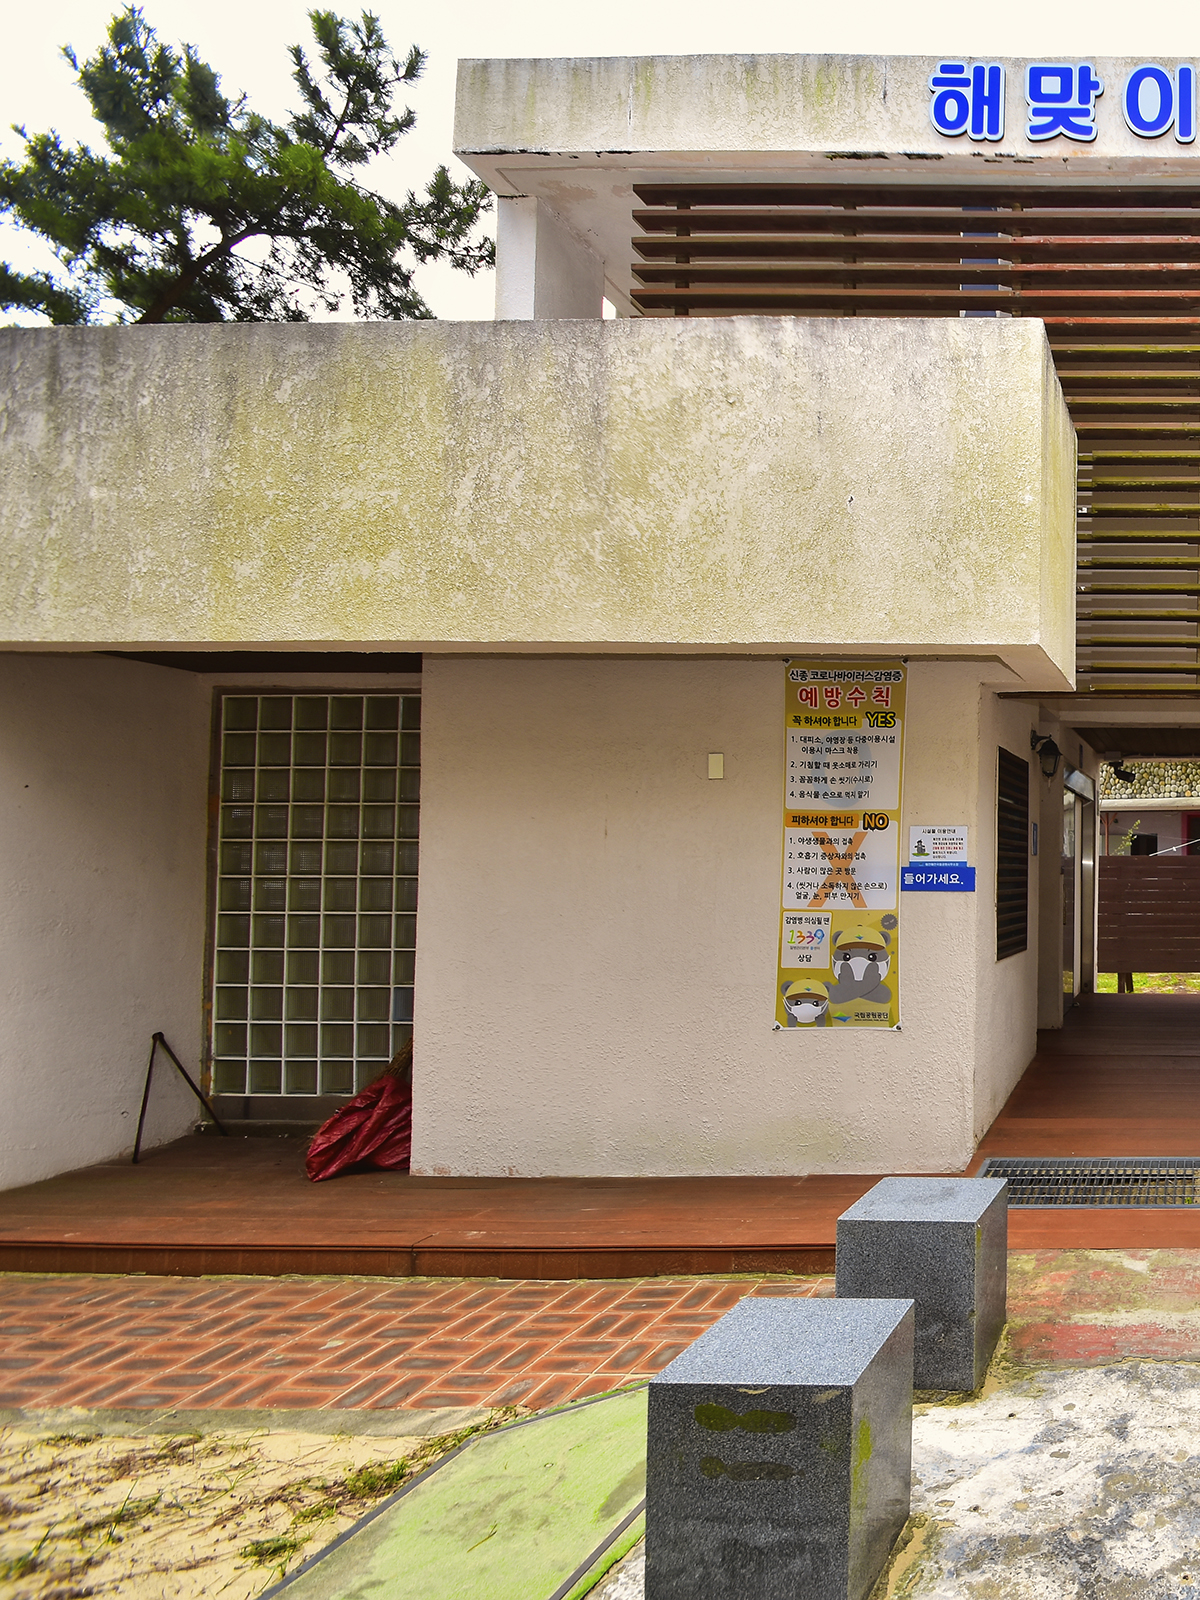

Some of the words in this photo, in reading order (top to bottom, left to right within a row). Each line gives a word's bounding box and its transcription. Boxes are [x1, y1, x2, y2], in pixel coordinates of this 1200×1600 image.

[789, 670, 808, 681] 신종
[810, 670, 902, 681] 코로나바이러스감염증
[792, 715, 802, 726] 꼭
[804, 715, 831, 726] 하셔야
[833, 715, 857, 726] 합니다
[865, 711, 896, 728] YES
[801, 746, 823, 755] 이용시
[825, 746, 845, 754] 마스크
[847, 746, 859, 754] 착용
[800, 761, 821, 769] 기침할
[823, 761, 830, 769] 때
[832, 761, 857, 769] 옷소매로
[858, 760, 878, 769] 가리기
[799, 776, 828, 784] 꼼꼼하게
[829, 776, 837, 784] 손
[799, 791, 820, 799] 음식물
[822, 791, 843, 799] 손으로
[845, 791, 856, 799] 먹지
[791, 815, 828, 826] 피하셔야
[830, 815, 854, 825] 합니다
[863, 812, 890, 831] NO
[789, 837, 796, 845] 1.
[842, 837, 853, 845] 접촉
[797, 852, 819, 860] 호흡기
[854, 852, 866, 860] 접촉
[797, 867, 818, 875] 사람이
[820, 867, 833, 875] 많은
[835, 867, 842, 875] 곳
[844, 867, 857, 875] 방문
[824, 891, 839, 900] 피부
[787, 928, 825, 945] 1339
